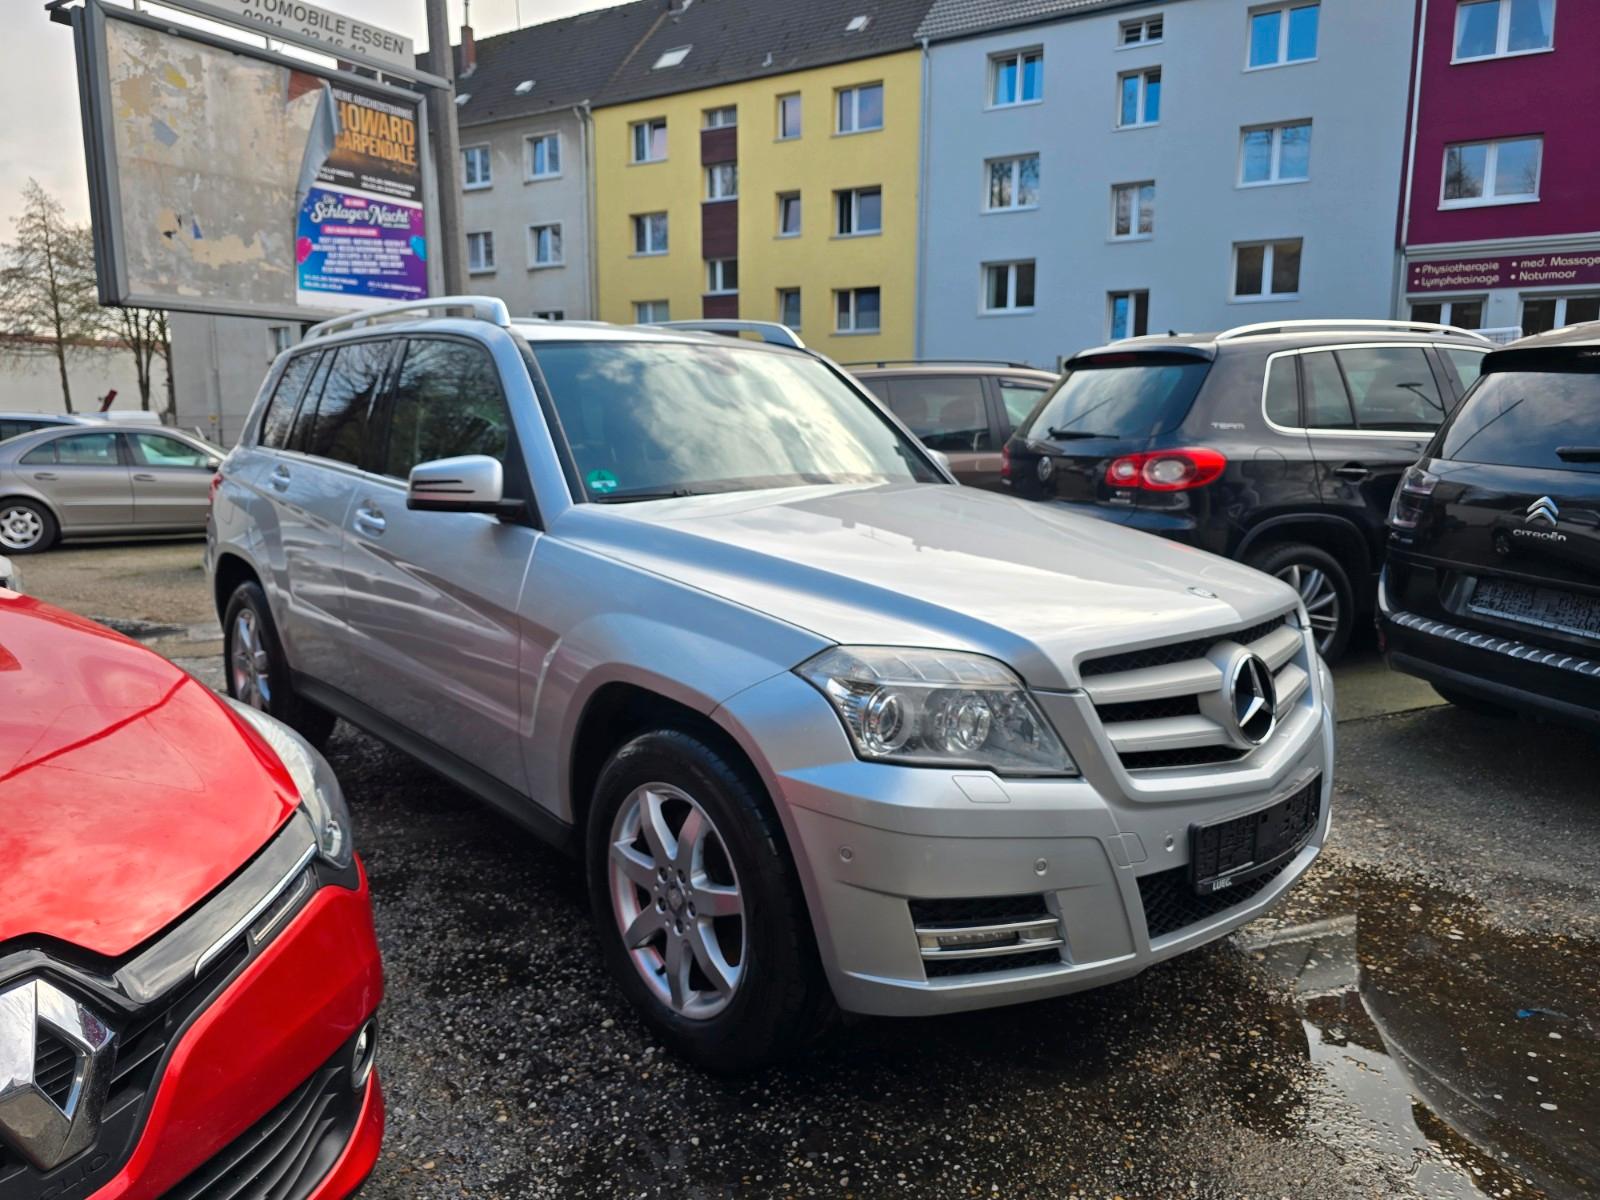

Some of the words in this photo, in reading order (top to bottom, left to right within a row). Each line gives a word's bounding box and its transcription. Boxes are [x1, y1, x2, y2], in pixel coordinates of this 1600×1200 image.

[240, 0, 346, 36] OMOBILE
[351, 24, 404, 54] ESSEN
[1421, 262, 1499, 275] Physiotherapie
[1520, 257, 1547, 268] med.
[1421, 274, 1499, 288] Lymphdrainage
[1519, 270, 1577, 281] Naturmoor
